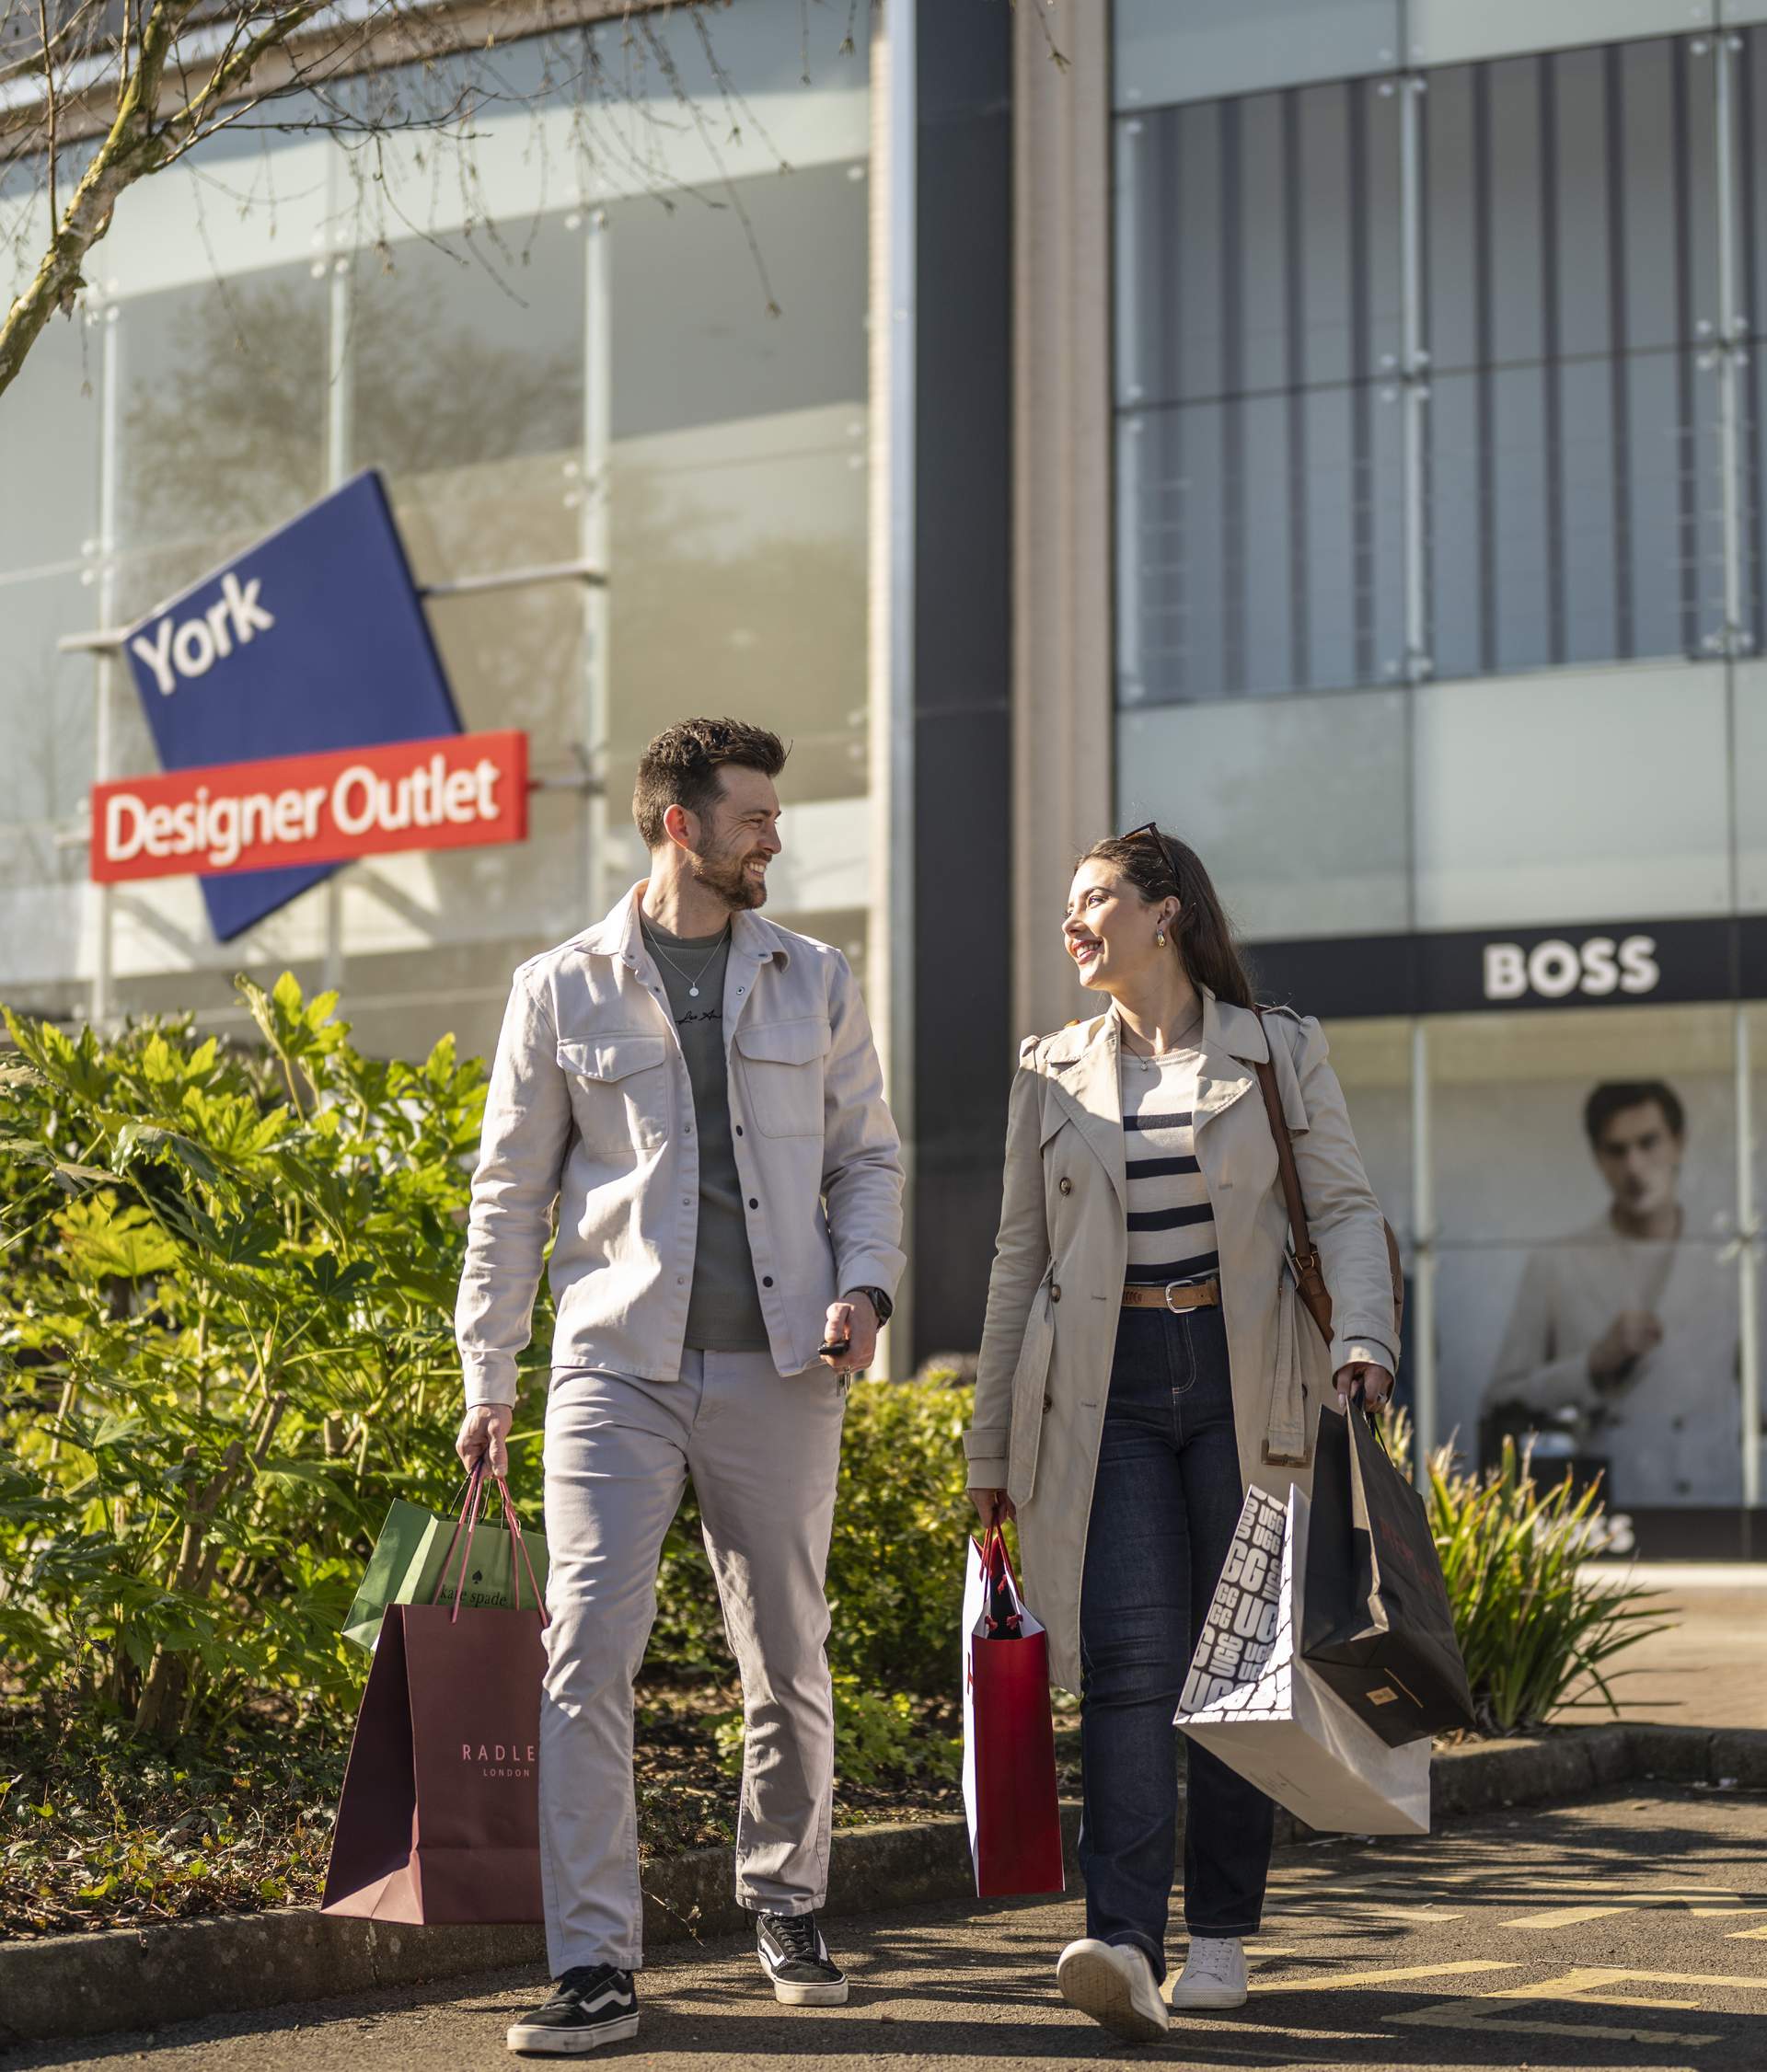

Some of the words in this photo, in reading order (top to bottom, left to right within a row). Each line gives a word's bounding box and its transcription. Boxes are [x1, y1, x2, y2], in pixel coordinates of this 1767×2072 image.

[133, 572, 274, 696] York
[105, 785, 328, 867] Designer
[331, 752, 500, 835] Outlet
[1483, 934, 1660, 1000] BOSS
[1258, 1503, 1285, 1537] UGG
[1252, 1524, 1281, 1557] UGG
[470, 1591, 507, 1608] spade
[462, 1744, 536, 1762] RADLE
[483, 1767, 530, 1778] LONDON
